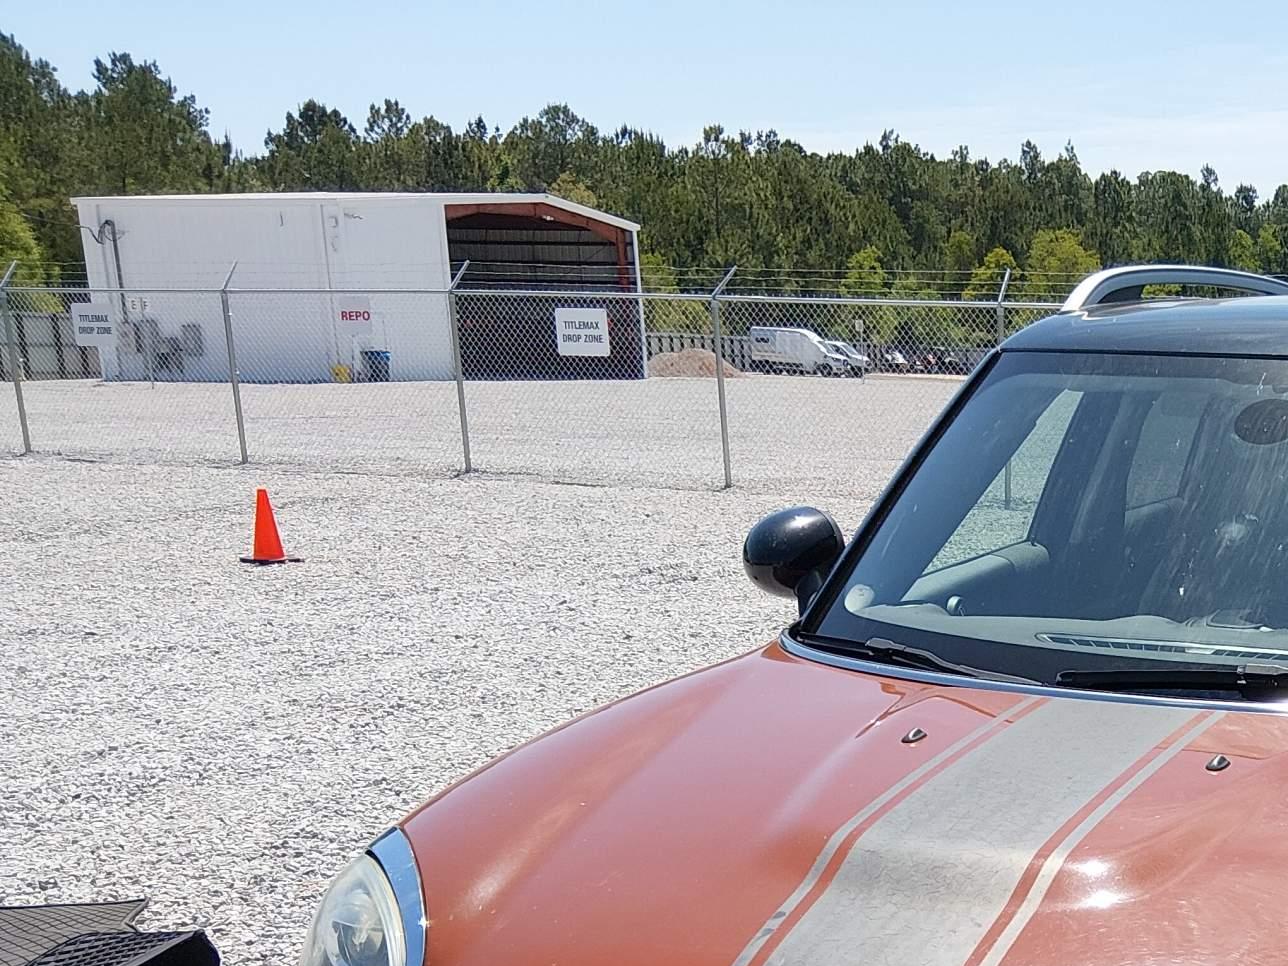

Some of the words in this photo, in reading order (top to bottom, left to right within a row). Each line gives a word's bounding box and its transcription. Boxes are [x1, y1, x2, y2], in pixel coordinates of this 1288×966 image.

[78, 314, 109, 323] TITLEMAX
[340, 310, 371, 321] REPO
[562, 320, 600, 330] TITLEMAX
[78, 326, 95, 335] DROP
[96, 326, 113, 335] ZONE
[562, 333, 582, 343] DROP
[583, 334, 605, 344] ZONE
